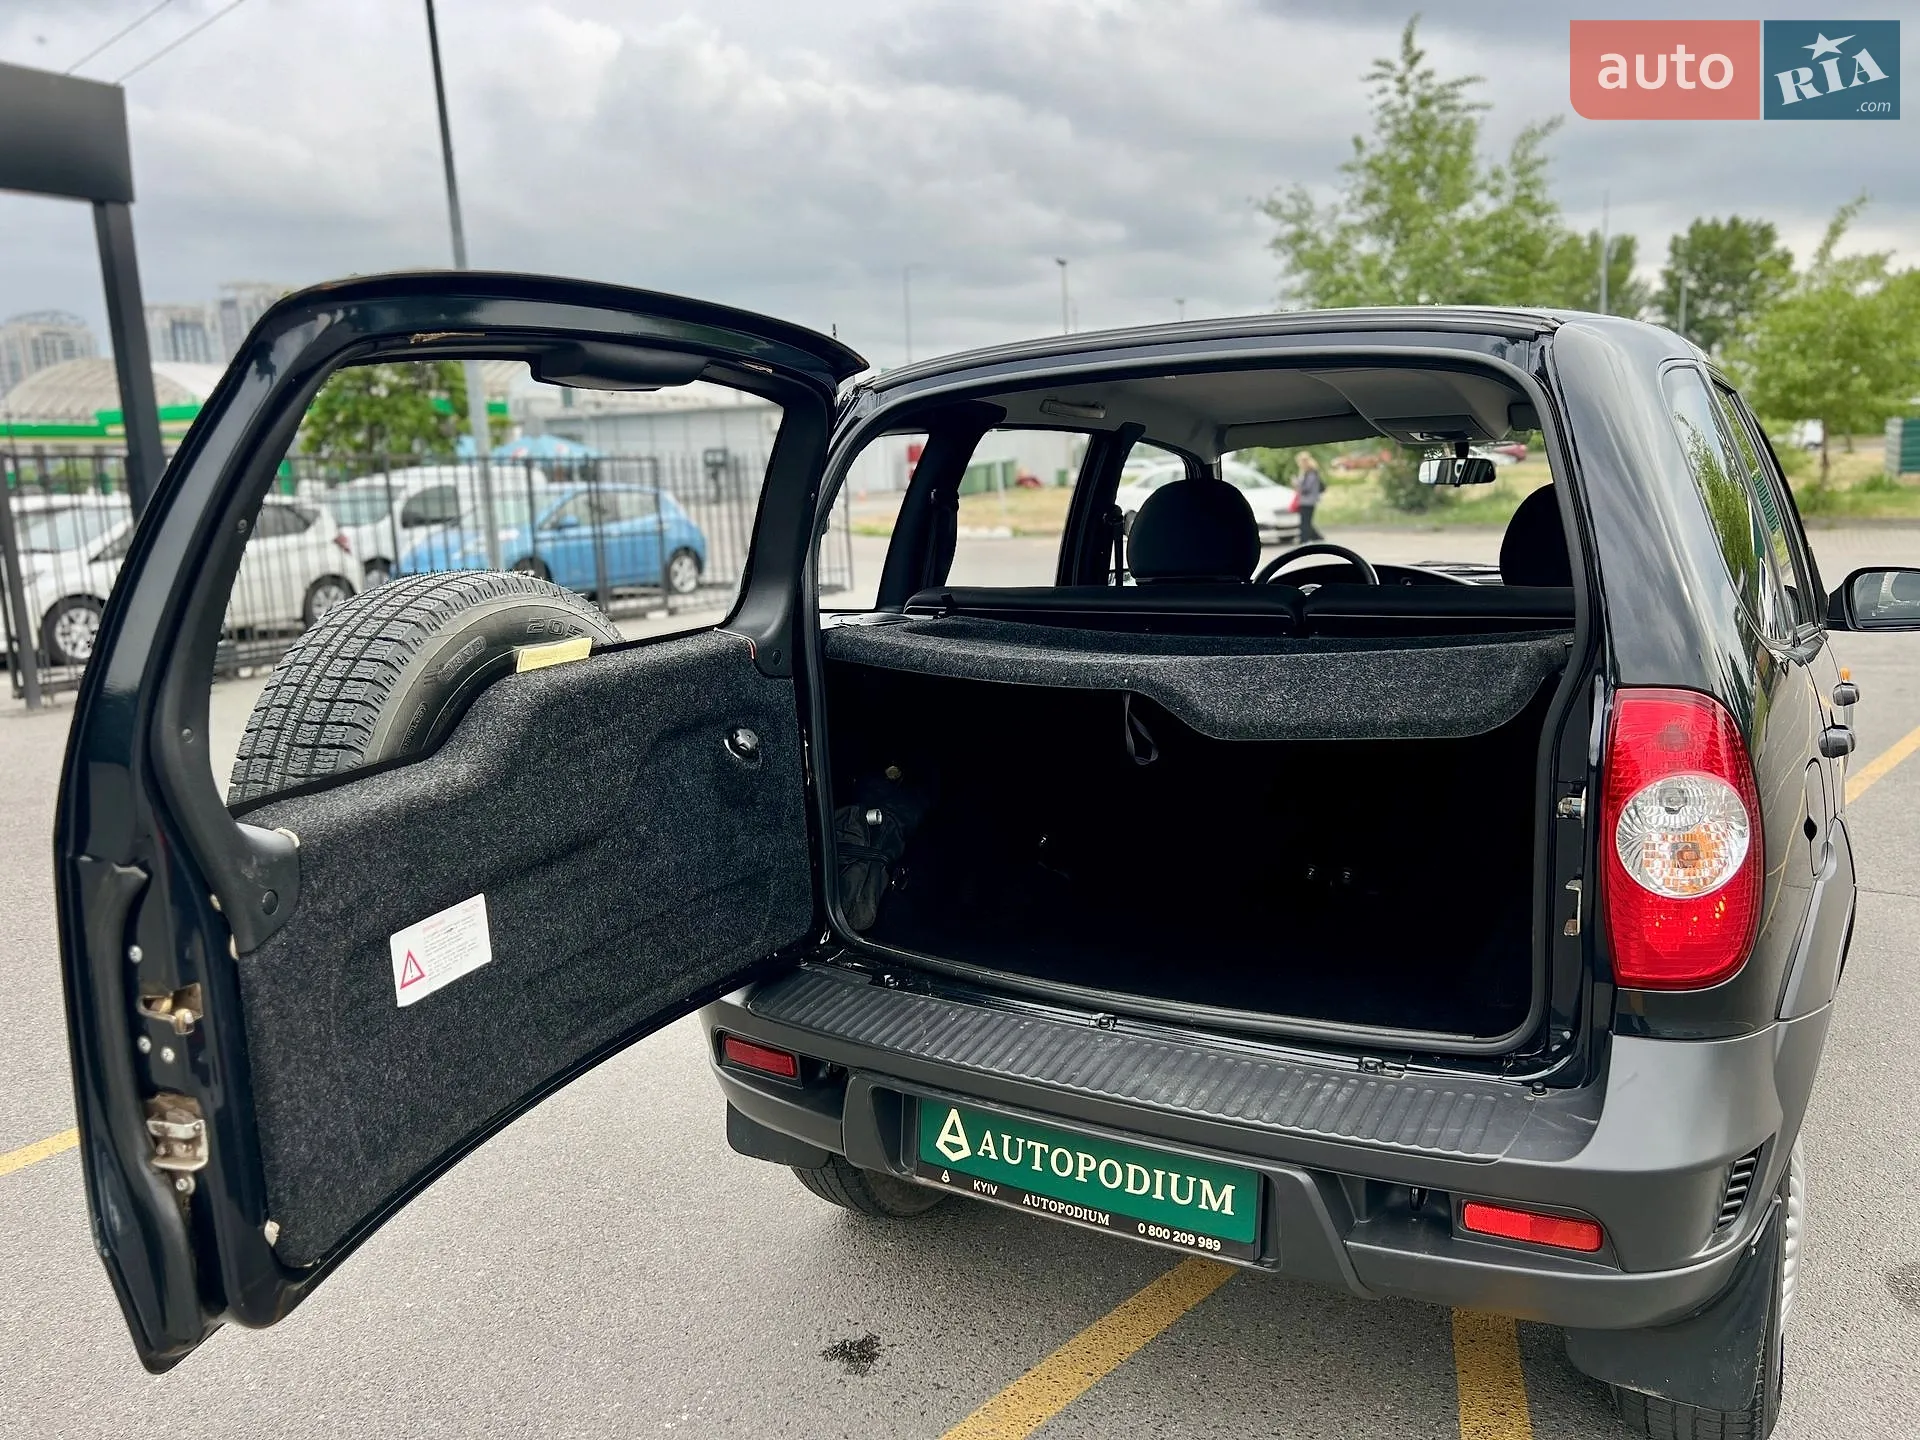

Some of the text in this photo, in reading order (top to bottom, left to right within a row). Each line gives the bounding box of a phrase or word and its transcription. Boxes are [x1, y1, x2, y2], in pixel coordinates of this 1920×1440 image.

[977, 1130, 1236, 1216] AUTOPODIUM
[973, 1179, 1221, 1252] KYIV AUTOPODIUM 0 800 209 989
